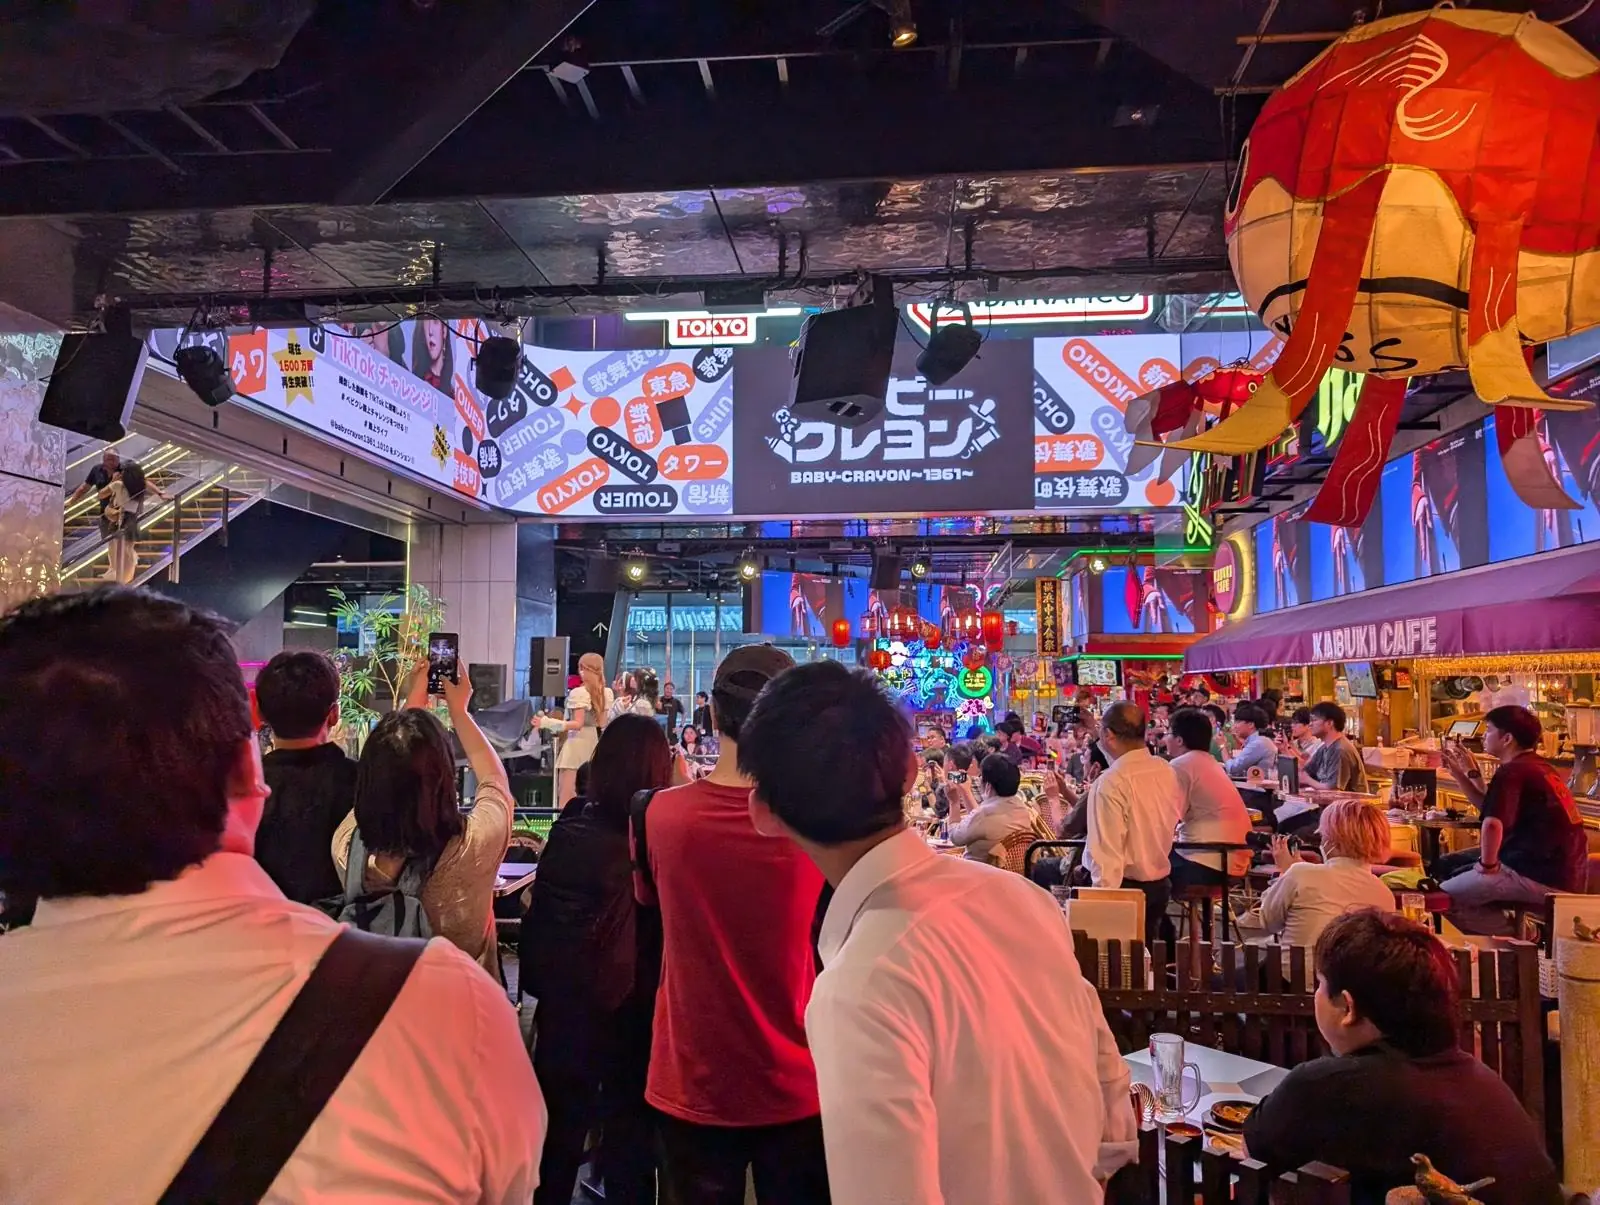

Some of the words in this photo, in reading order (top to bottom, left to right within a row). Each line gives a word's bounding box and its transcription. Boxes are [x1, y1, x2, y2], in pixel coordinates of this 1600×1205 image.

[679, 318, 746, 337] TOKYO
[647, 370, 692, 397] 東急
[501, 412, 561, 456] TOWER
[628, 402, 654, 445] 新宿
[794, 417, 974, 463] クレヨン
[496, 447, 564, 500] 歌舞伎町
[592, 432, 652, 481] TOKYO
[663, 453, 722, 475] タワー
[541, 463, 606, 509] TOKYU
[599, 491, 672, 508] TOWER
[688, 484, 729, 505] 新宿
[1034, 475, 1122, 498] 歌舞伎町
[1312, 624, 1376, 661] KABUKI
[1379, 616, 1437, 656] CAFE
